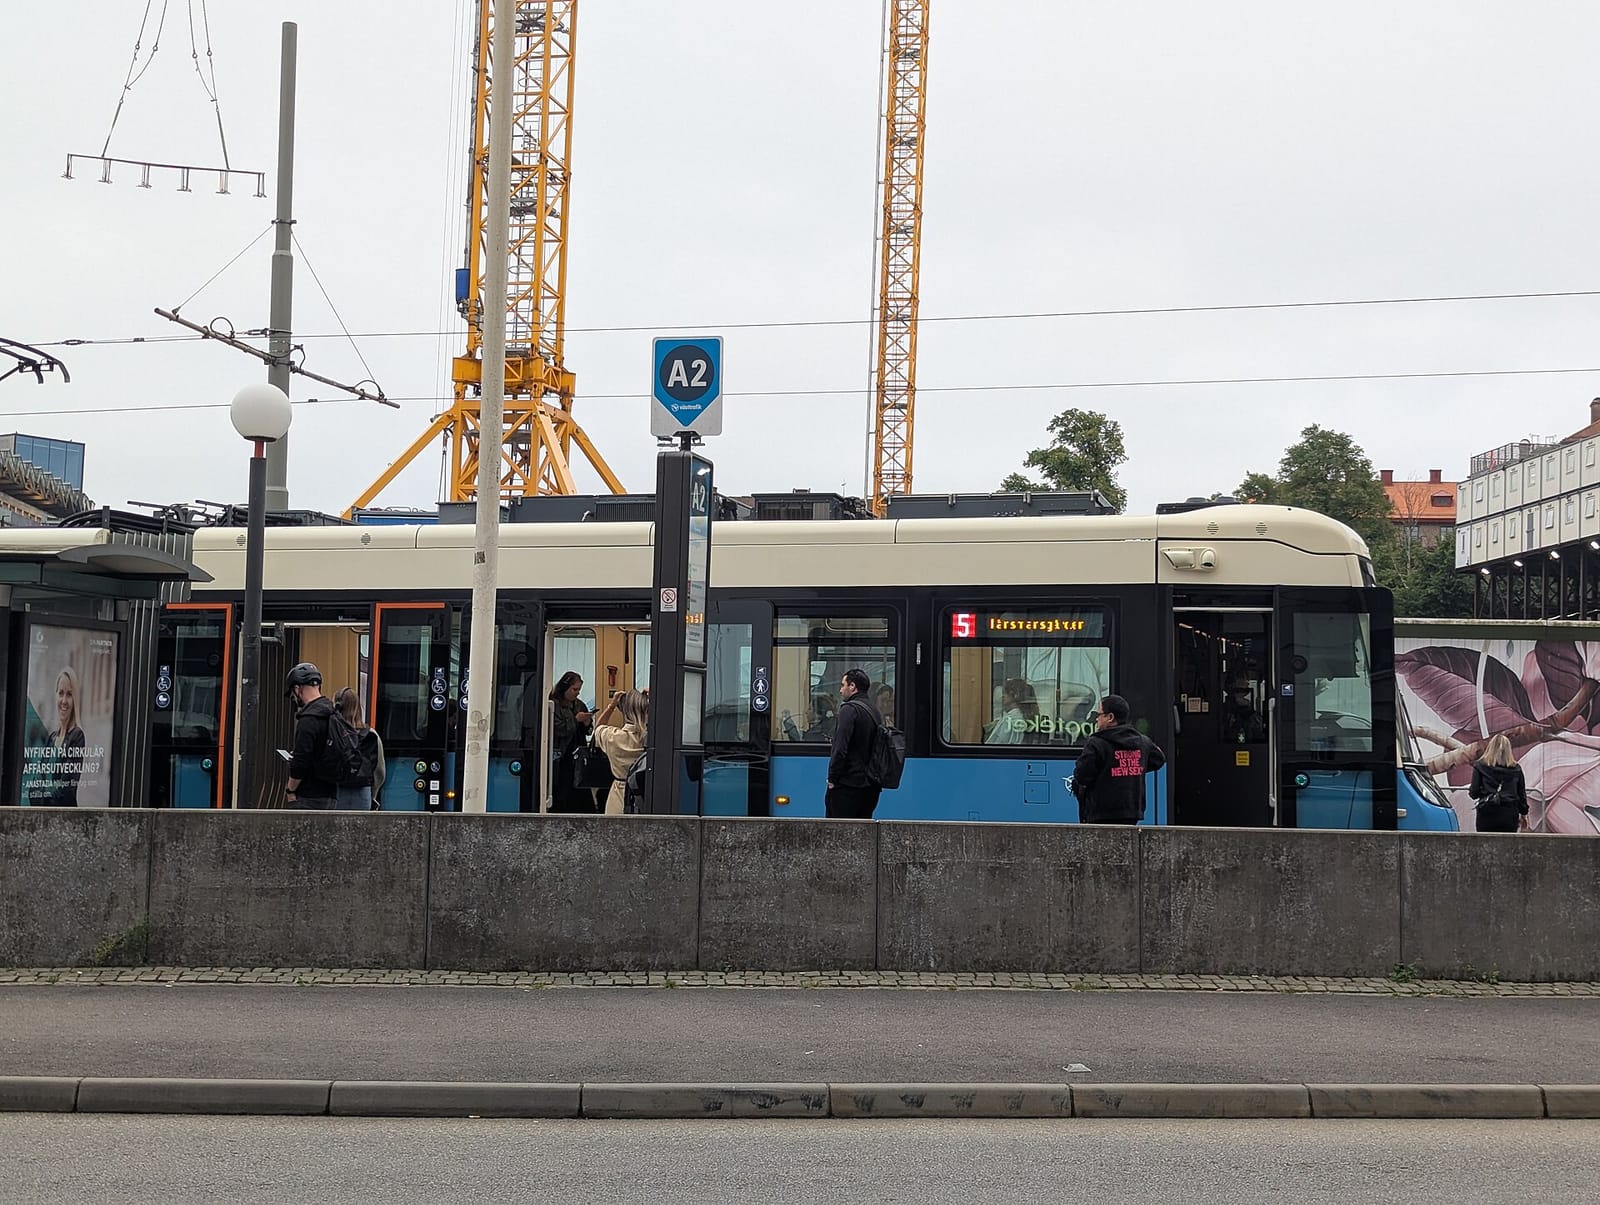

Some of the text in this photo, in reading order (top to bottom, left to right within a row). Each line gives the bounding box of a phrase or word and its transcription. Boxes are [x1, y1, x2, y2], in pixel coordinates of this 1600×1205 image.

[667, 359, 707, 387] A2
[692, 481, 706, 512] A2
[957, 613, 970, 638] 5
[24, 743, 104, 759] NYFIKEN PÅ CIRKULÄR
[23, 760, 100, 774] AFFÄRSUTVECKLING?
[1119, 759, 1140, 767] IS THE
[1111, 767, 1128, 777] NEW
